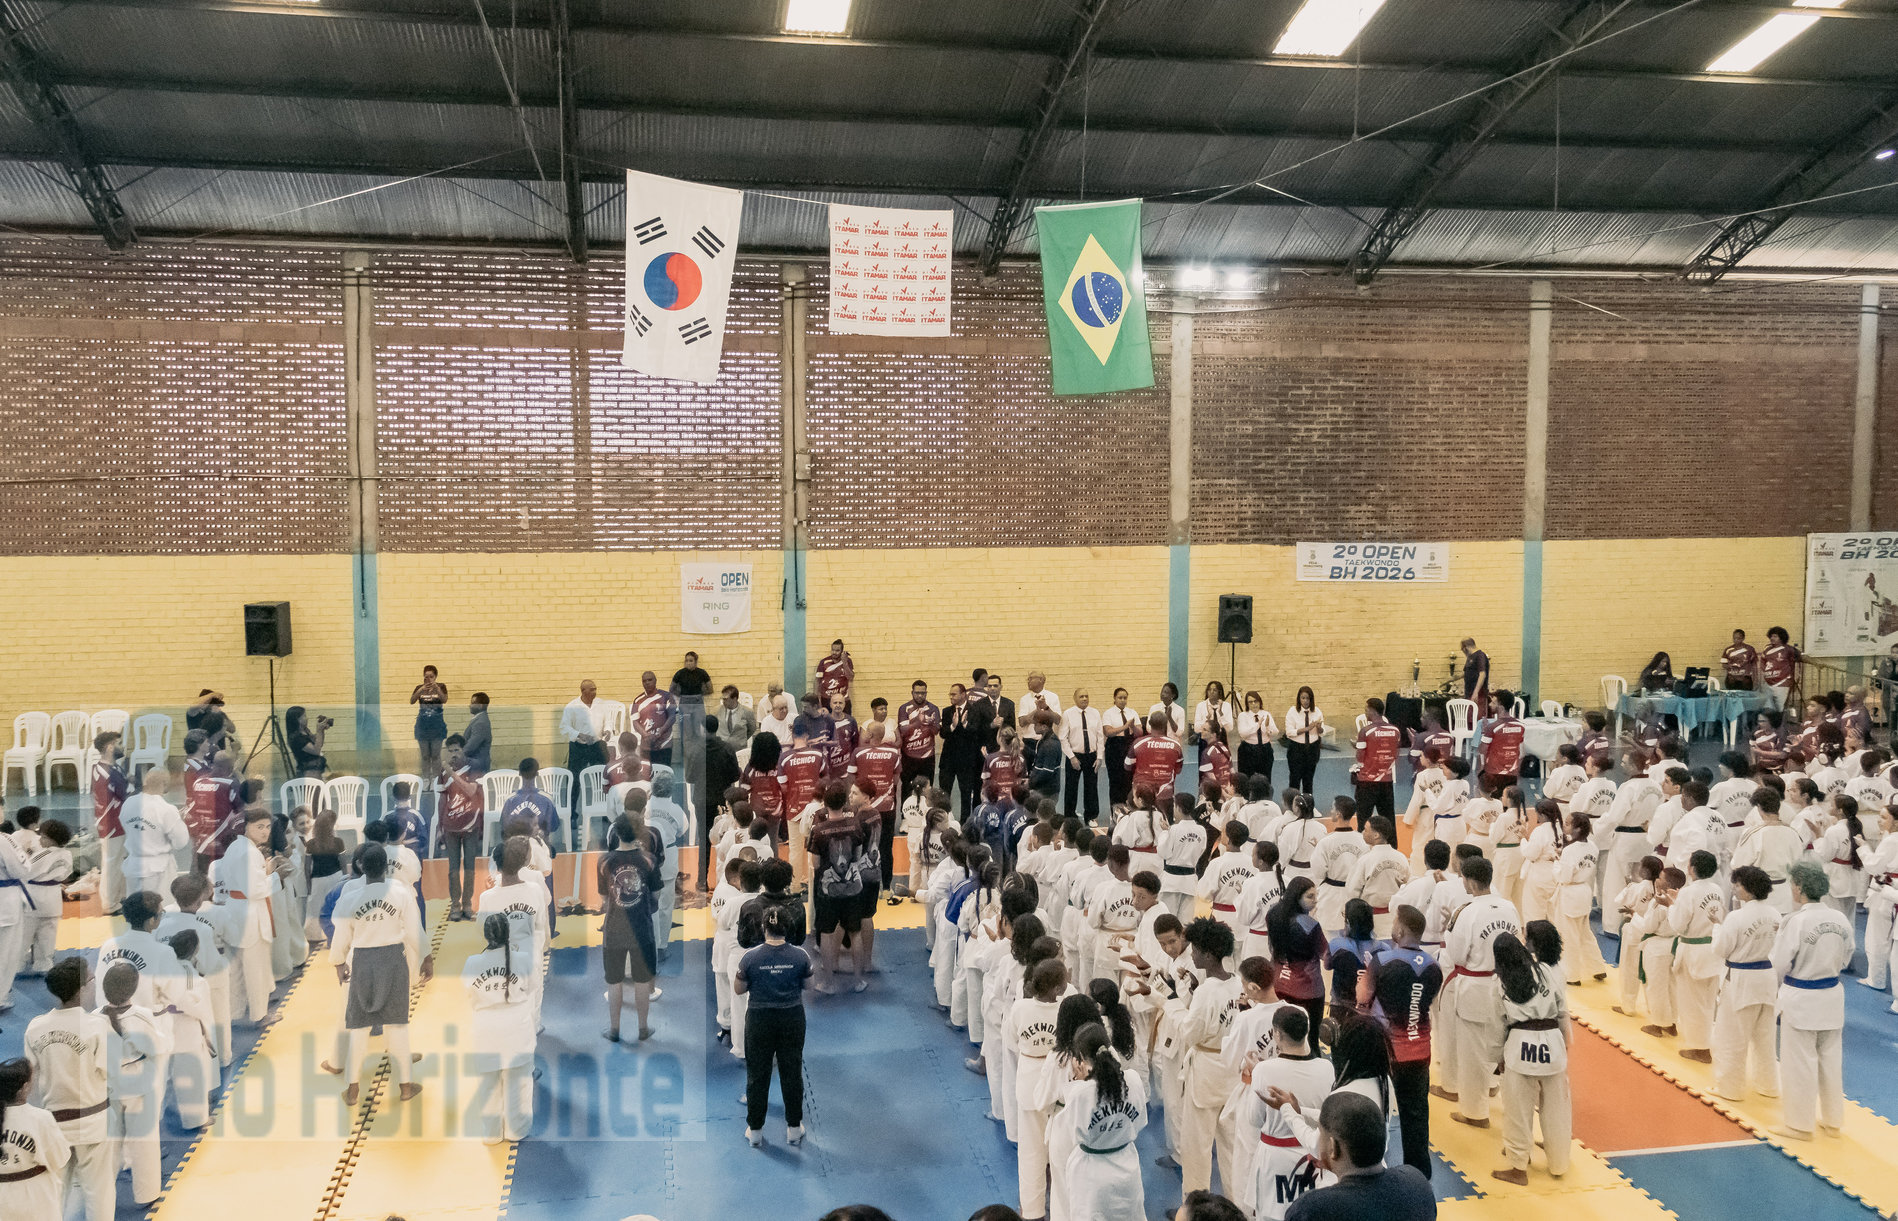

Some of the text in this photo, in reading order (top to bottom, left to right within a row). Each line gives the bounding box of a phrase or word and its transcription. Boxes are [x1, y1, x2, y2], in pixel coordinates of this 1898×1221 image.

[1362, 545, 1416, 560] OPEN
[1840, 551, 1870, 559] BH
[721, 572, 749, 586] OPEN
[1330, 567, 1415, 580] BH 2026
[1147, 740, 1175, 749] TÉCNICO
[790, 756, 816, 766] TÉCNICO
[504, 903, 536, 916] EKWONDO
[1110, 898, 1134, 913] TAEKW
[102, 949, 146, 971] TAEKWONDO
[472, 967, 518, 989] TAEKWODO
[1408, 983, 1424, 1042] TAEKWONDO
[1020, 1022, 1056, 1040] TAEKWO
[1521, 1042, 1551, 1064] MG
